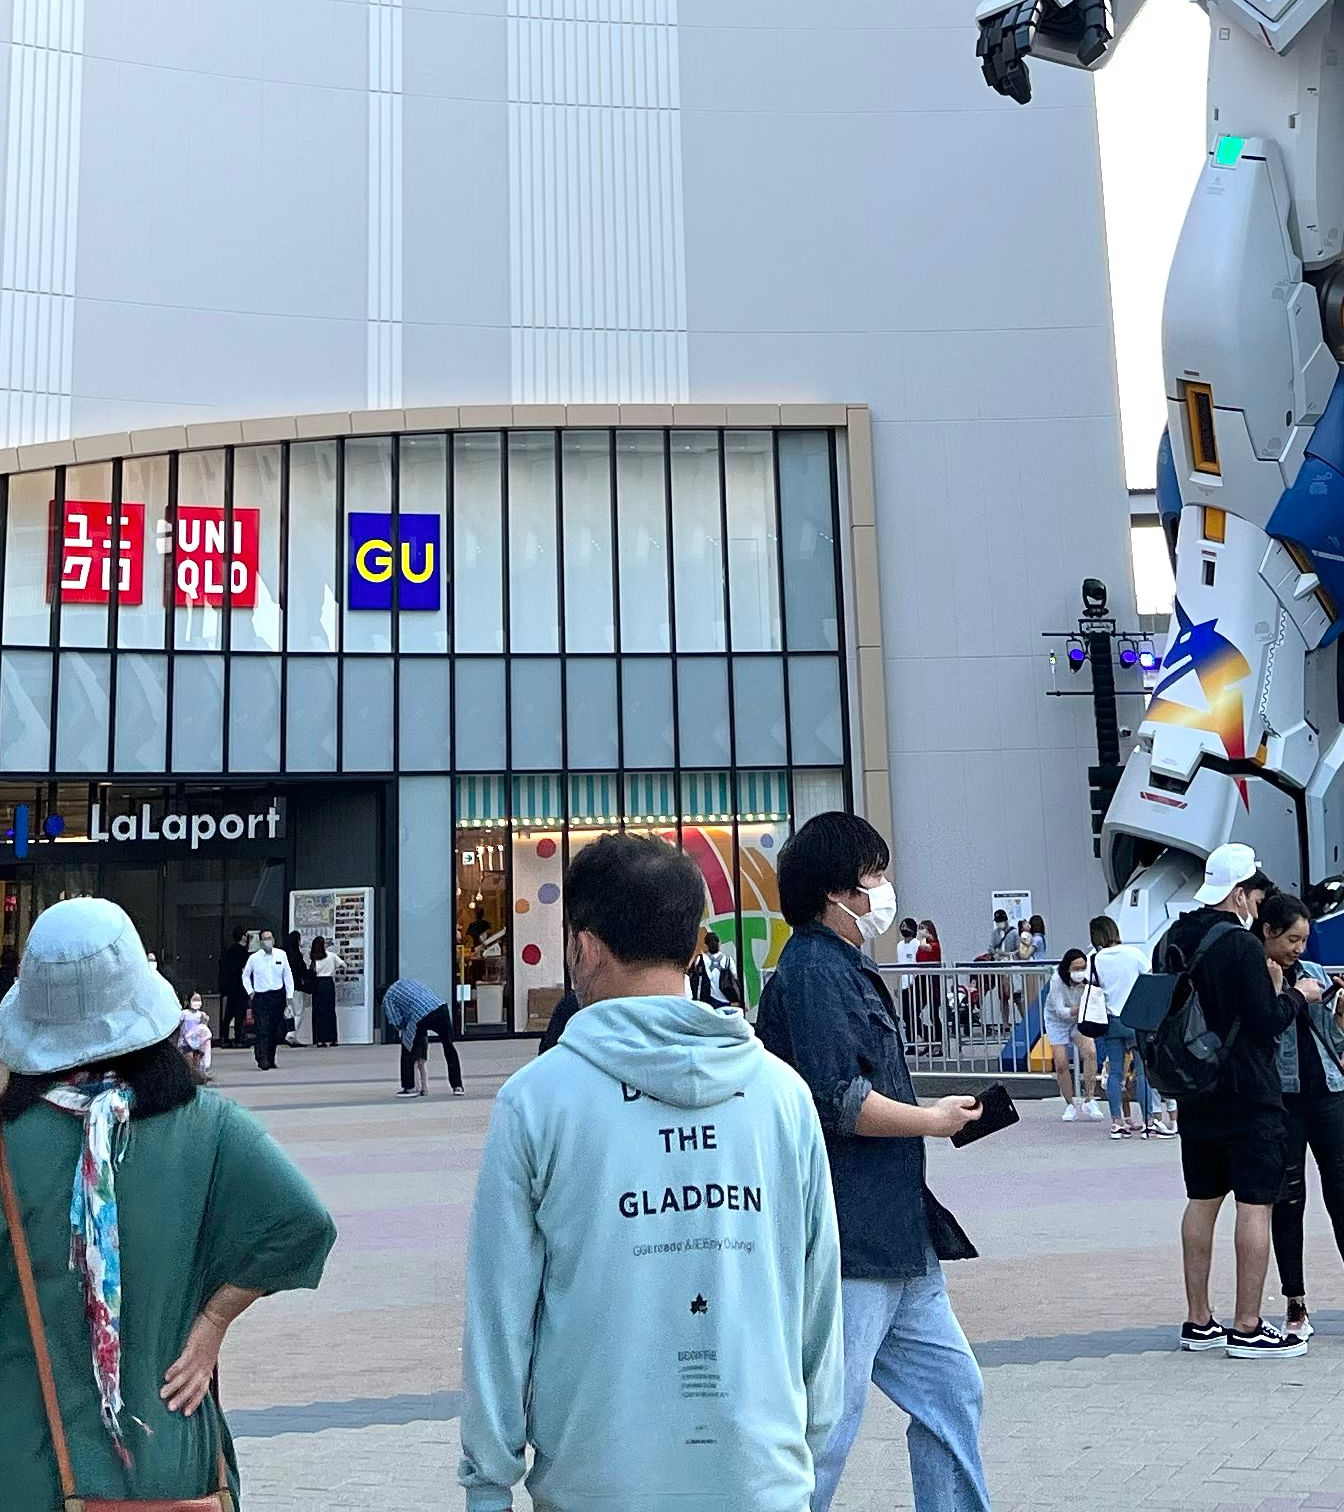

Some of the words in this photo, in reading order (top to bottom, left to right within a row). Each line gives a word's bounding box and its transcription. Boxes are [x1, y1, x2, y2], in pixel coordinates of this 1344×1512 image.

[63, 514, 131, 549] ユニ
[178, 519, 242, 554] UNI
[60, 556, 131, 591] クロ
[356, 539, 434, 583] GU
[177, 559, 248, 599] QLO
[91, 796, 280, 849] LaLaport
[659, 1124, 718, 1153] THE
[619, 1183, 762, 1219] GLADDEN
